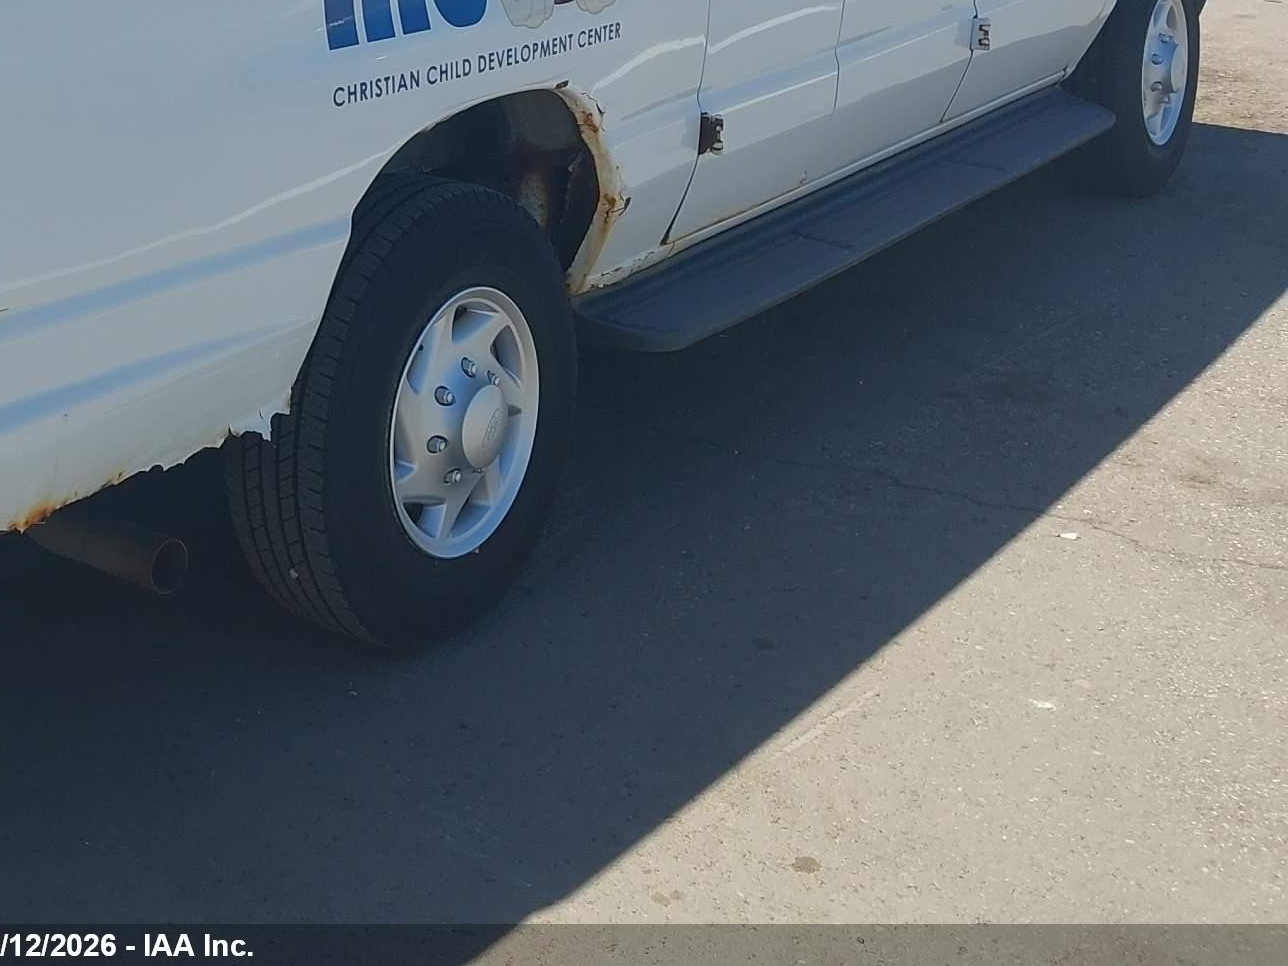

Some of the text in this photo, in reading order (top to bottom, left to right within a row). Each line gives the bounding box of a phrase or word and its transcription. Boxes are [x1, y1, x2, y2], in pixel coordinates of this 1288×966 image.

[333, 22, 621, 107] CHRISTIAN CHILD DEVELOPMENT CENTER
